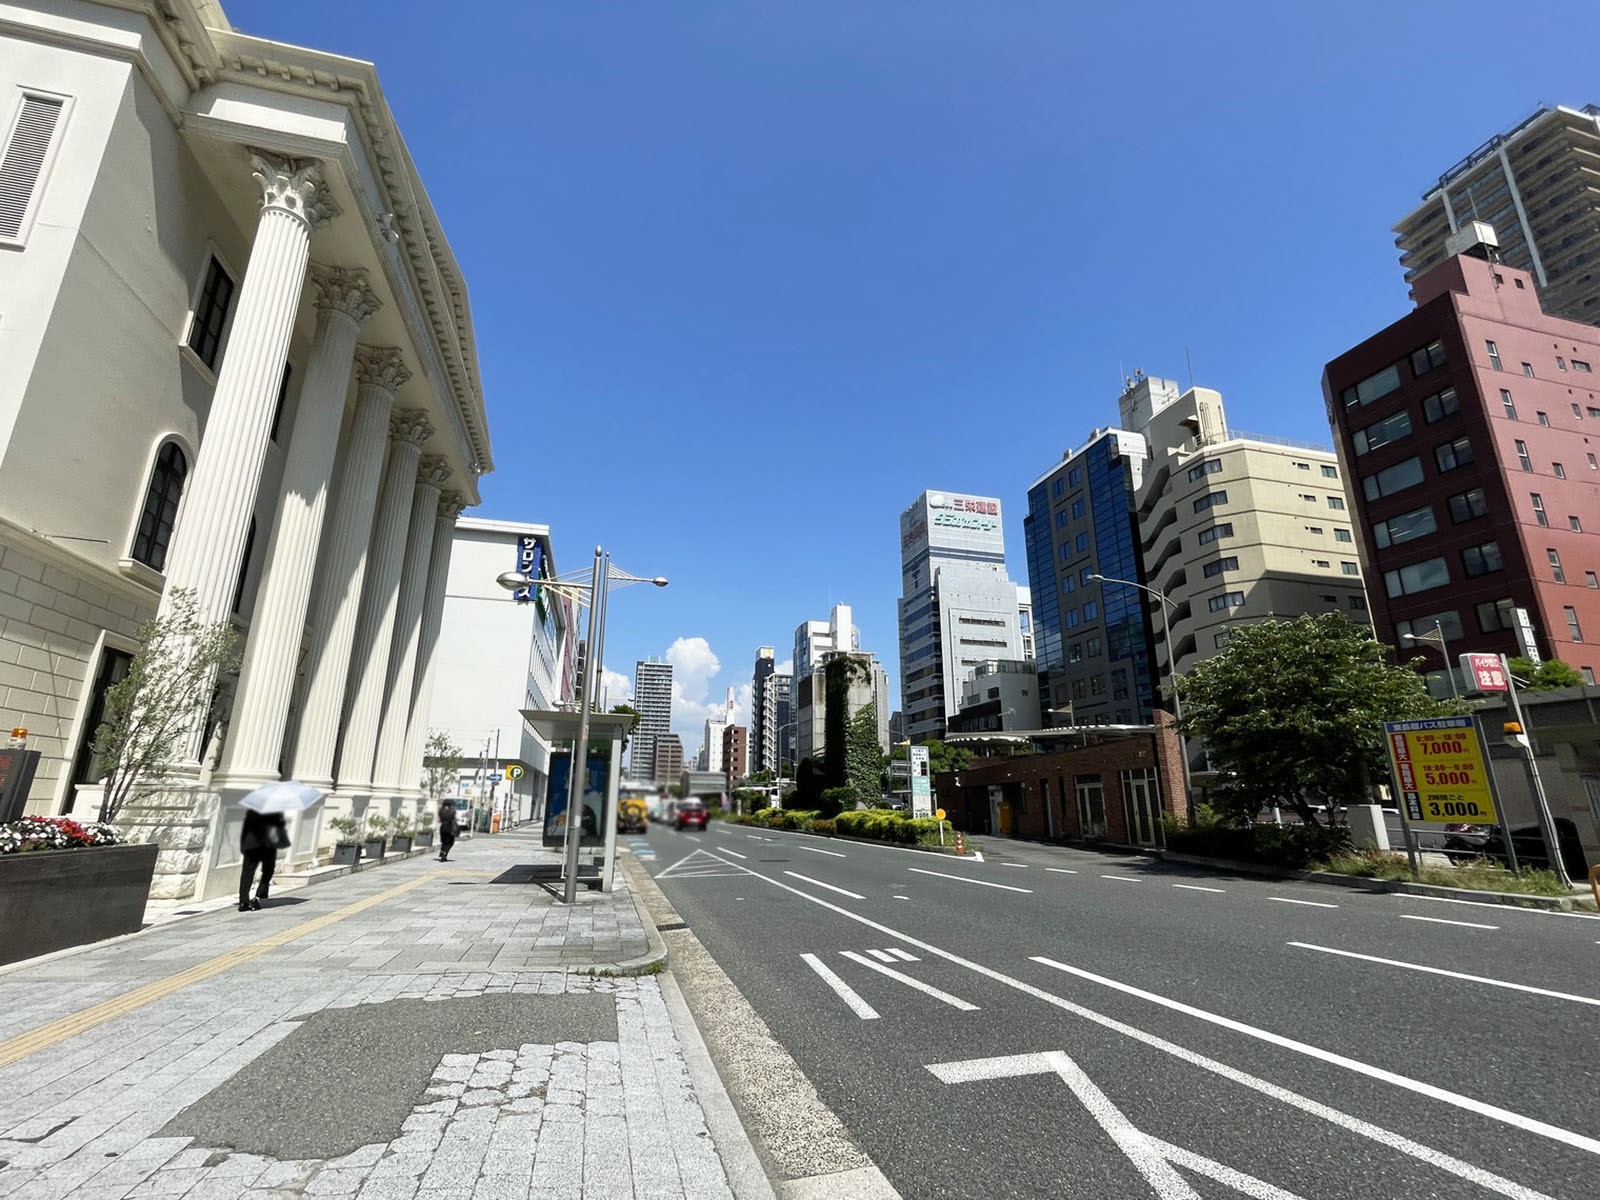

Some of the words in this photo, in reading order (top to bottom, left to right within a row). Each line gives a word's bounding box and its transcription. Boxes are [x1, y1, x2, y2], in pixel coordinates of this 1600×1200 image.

[518, 537, 537, 598] サロンス
[513, 768, 522, 778] P
